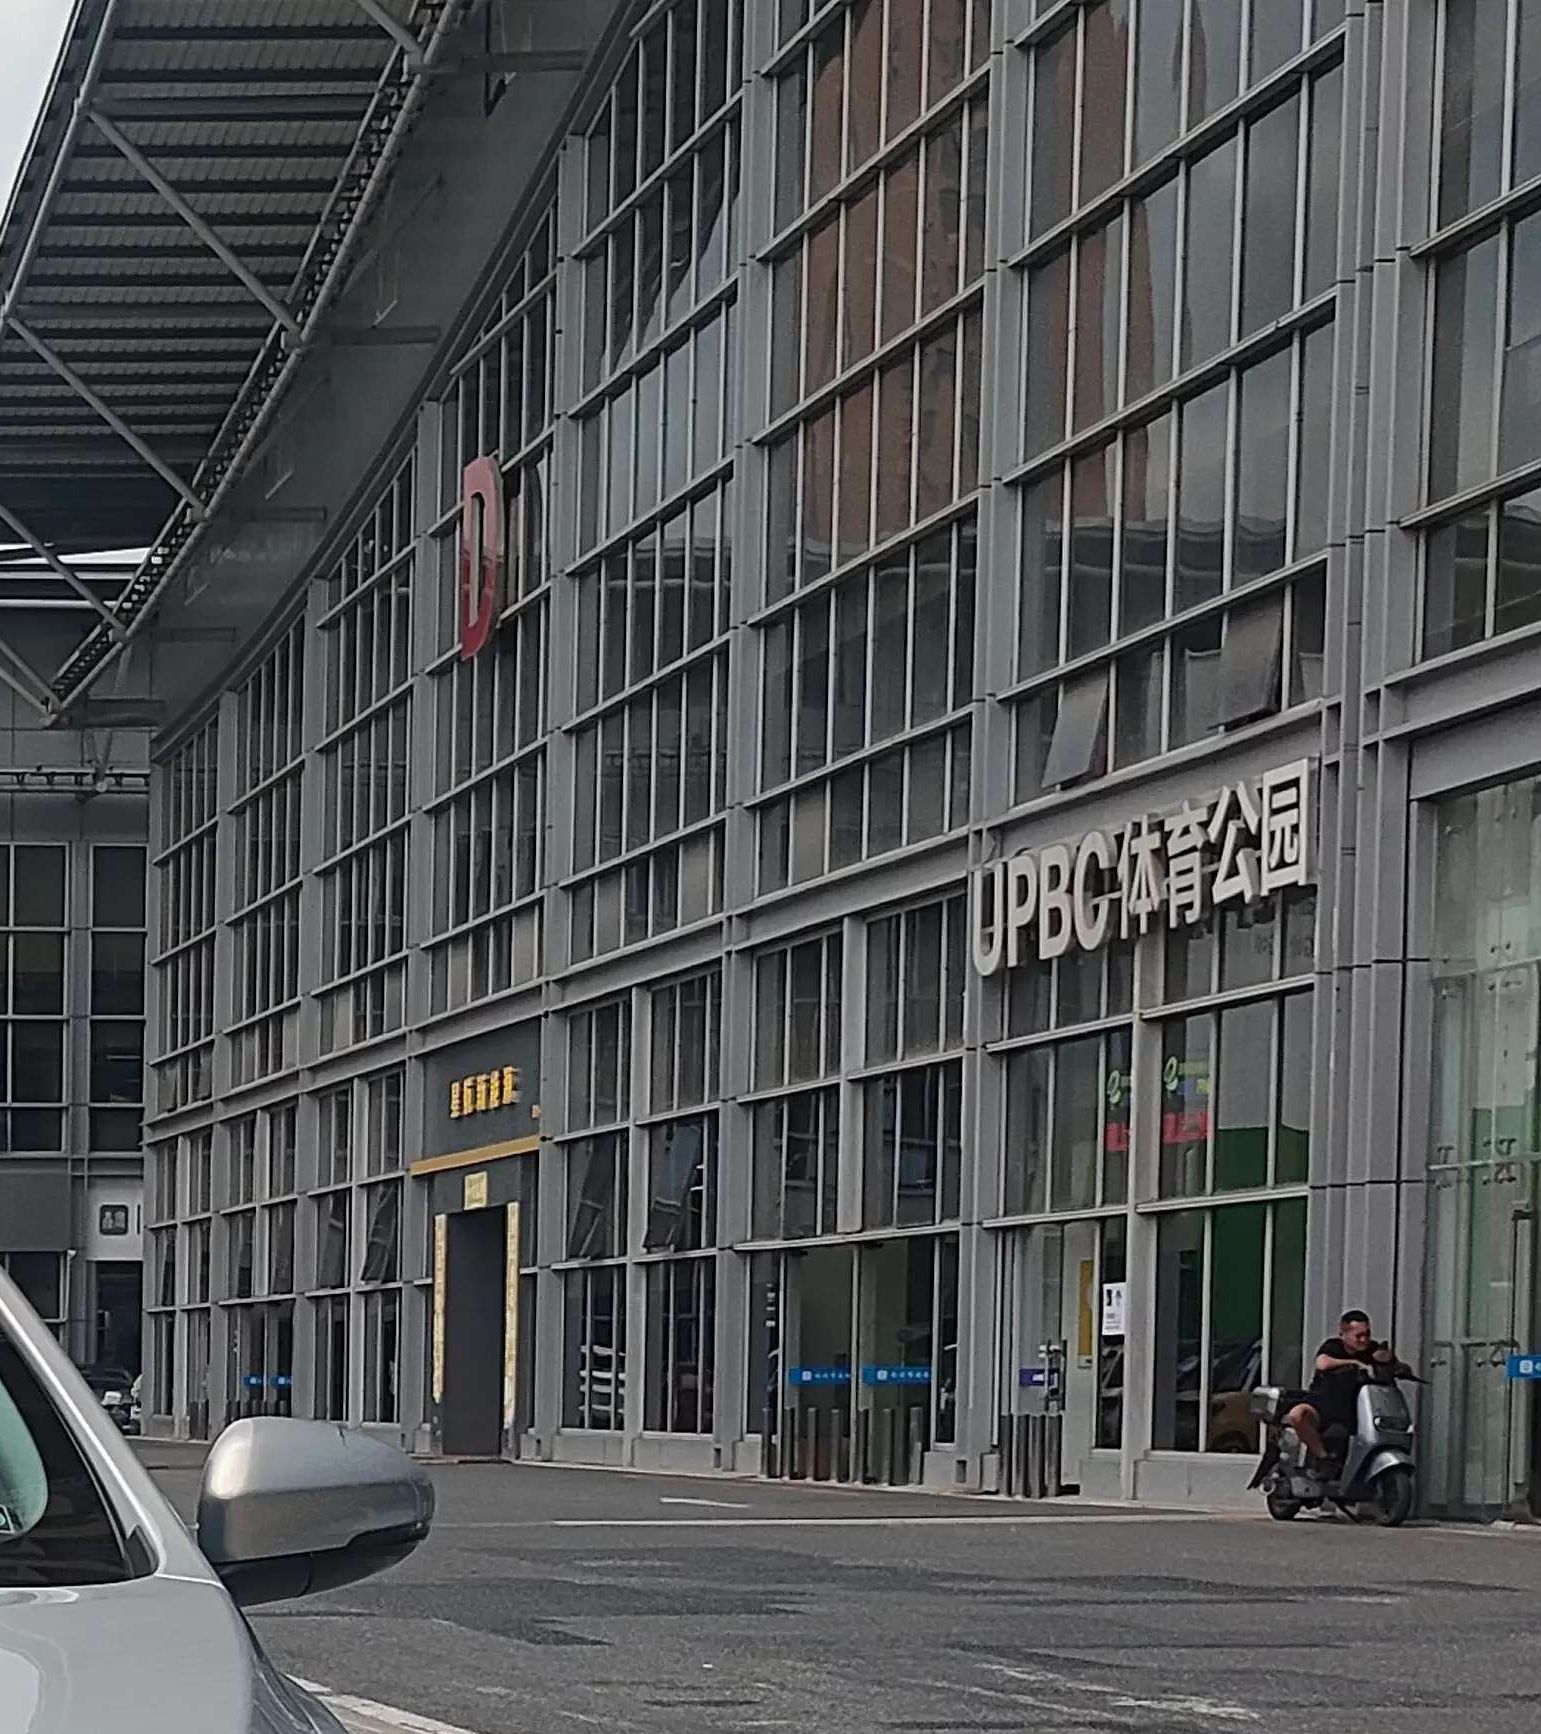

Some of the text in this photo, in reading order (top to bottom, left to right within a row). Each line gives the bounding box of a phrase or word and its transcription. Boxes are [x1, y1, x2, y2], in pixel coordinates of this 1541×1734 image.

[461, 456, 504, 661] D
[972, 756, 1317, 976] UPBC体育公园
